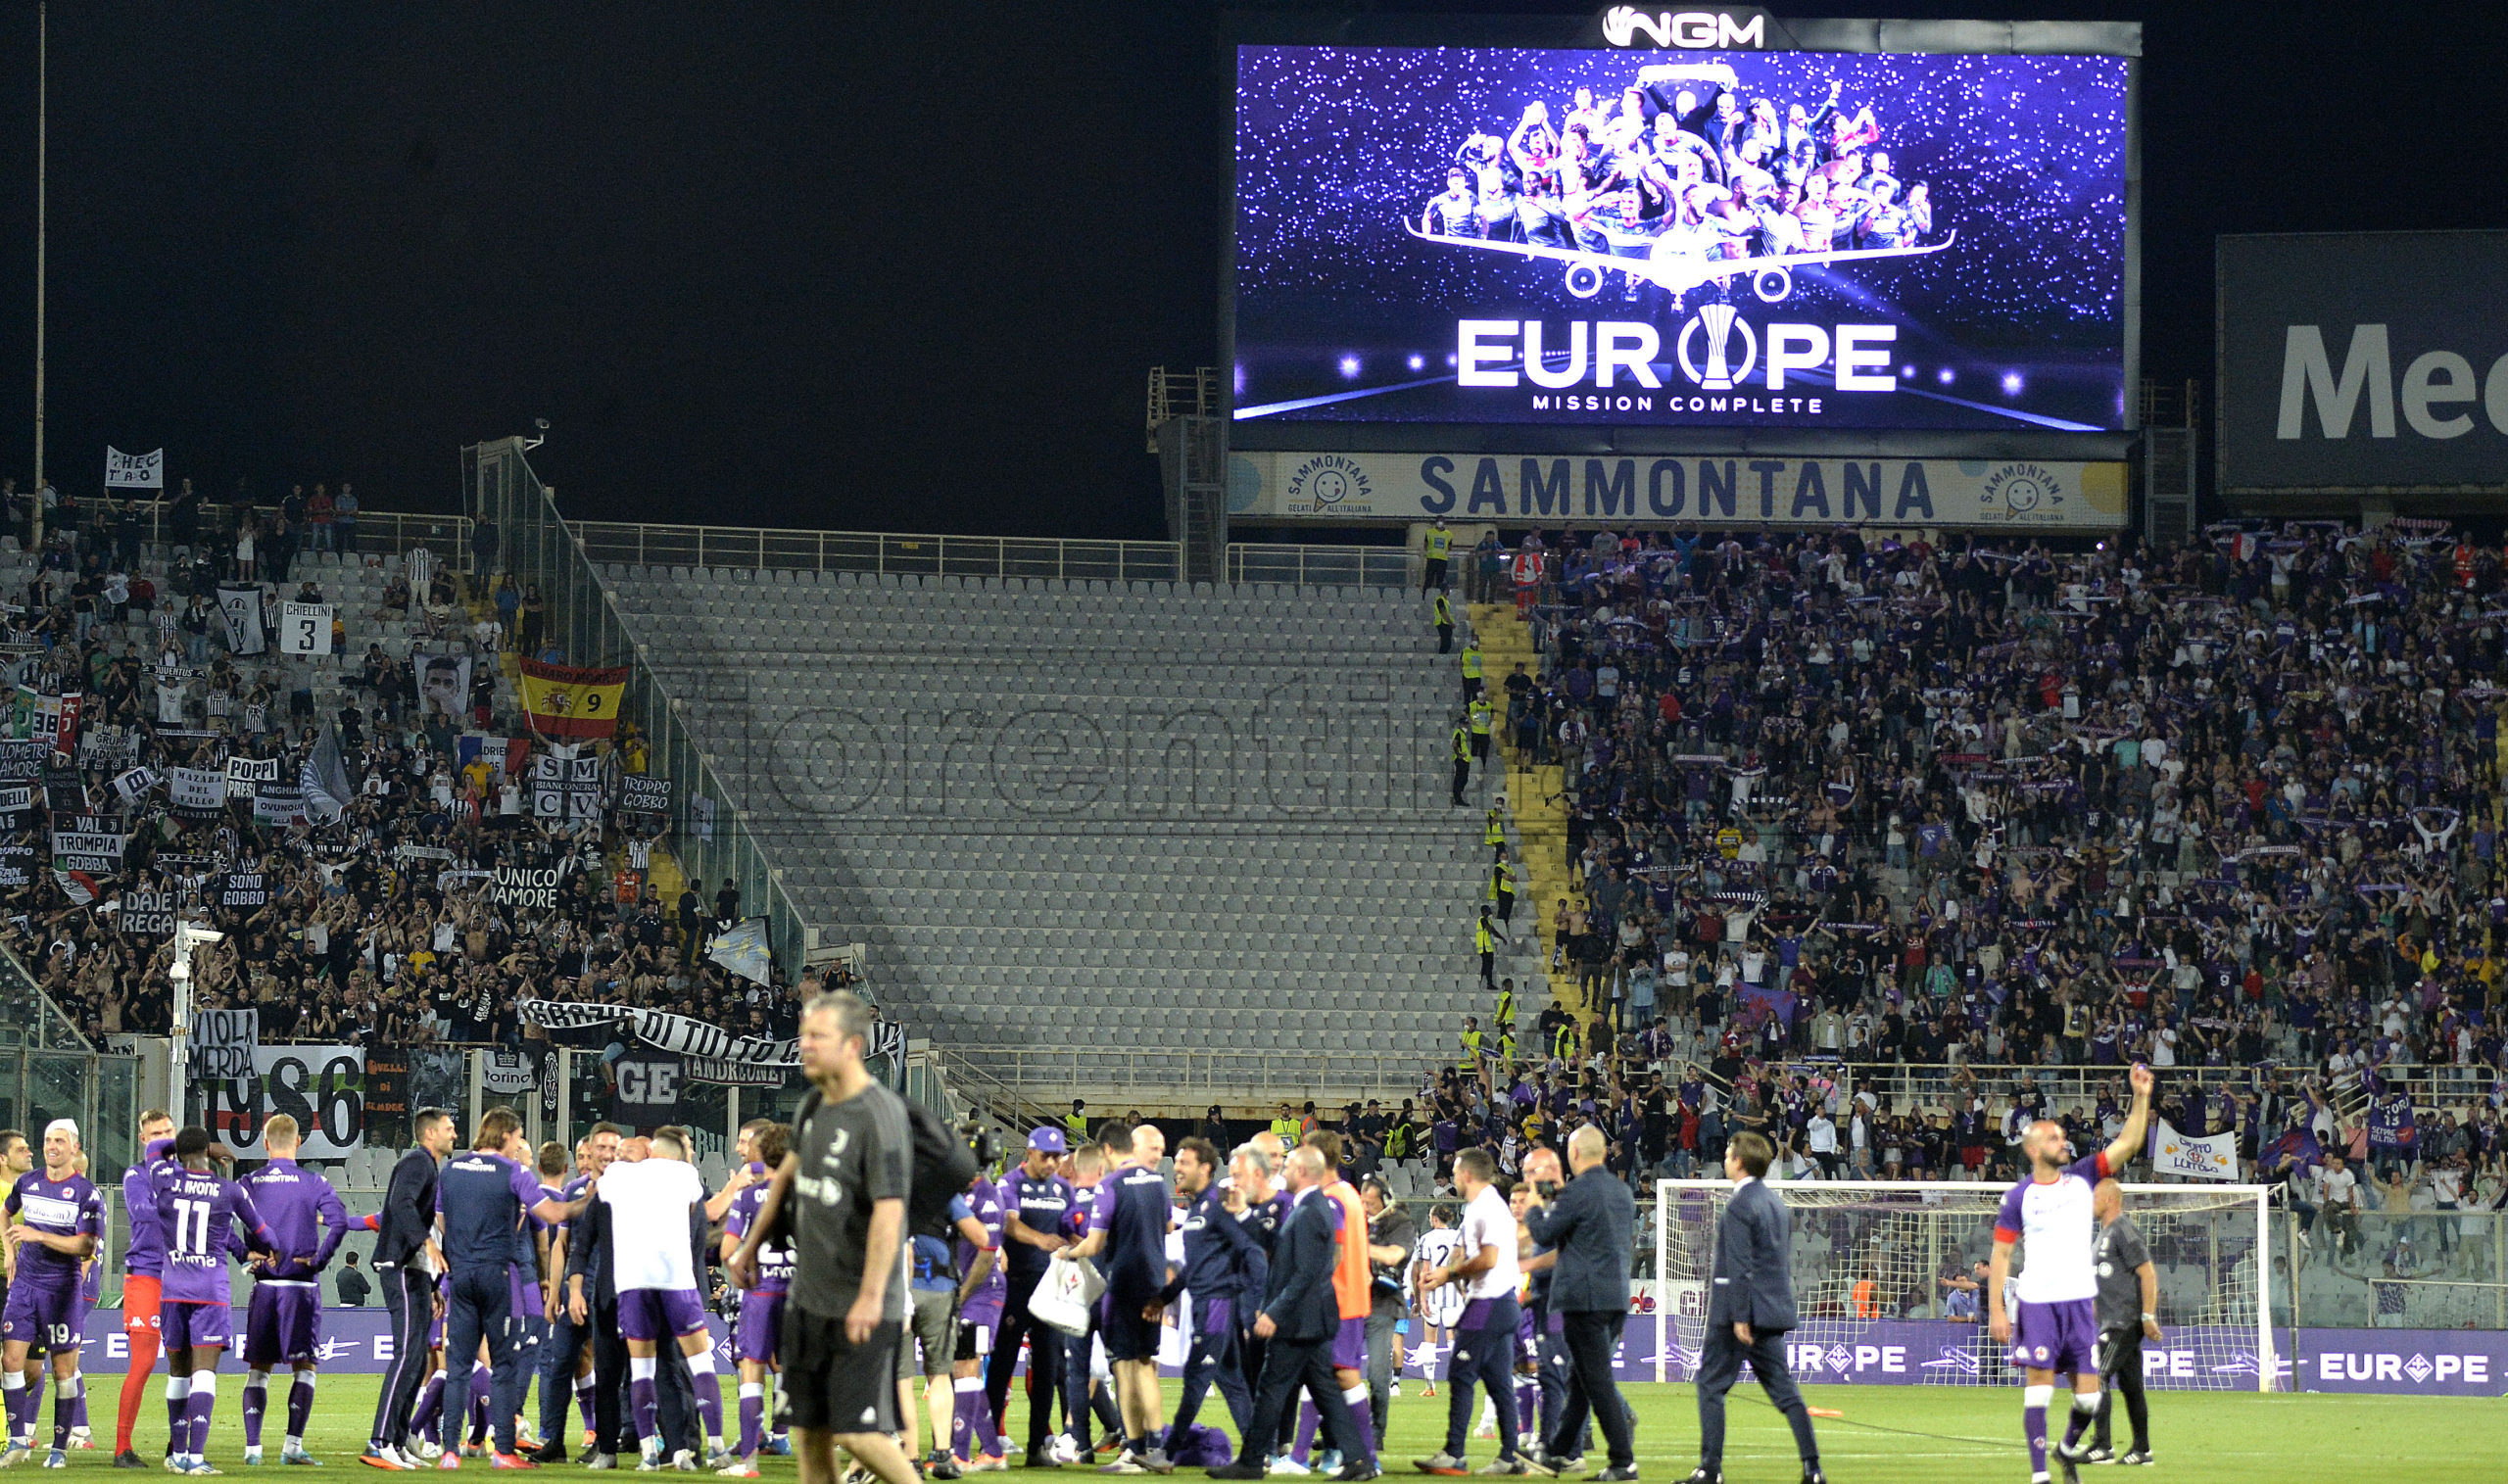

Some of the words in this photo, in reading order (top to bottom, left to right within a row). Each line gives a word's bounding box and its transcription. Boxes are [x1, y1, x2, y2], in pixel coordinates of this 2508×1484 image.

[1616, 12, 1763, 49] NGM
[1532, 396, 1652, 412] MISSION
[1669, 397, 1823, 414] COMPLETE
[1288, 455, 1372, 496] SAMMONTANA
[1980, 463, 2063, 504] SAMMONTANA
[1420, 455, 1935, 523] SAMMONTANA
[1288, 503, 1312, 512] GELATI
[1326, 503, 1372, 513] ALL'ITALIANA
[1980, 512, 2003, 521] GELATI
[286, 604, 331, 618] CHIELLINI
[299, 620, 316, 651] 3
[155, 665, 193, 677] JUVENTUS
[588, 694, 602, 713] 9
[96, 735, 130, 746] GRUPPO
[0, 743, 48, 760] LOMETRI
[177, 771, 221, 783] MAZARA
[230, 759, 275, 780] POPPI
[188, 785, 210, 794] DEL
[261, 785, 302, 794] ANGHIA
[536, 783, 598, 793] BIANCONERA
[624, 777, 672, 795] TROPPO
[179, 794, 215, 805] VALLO
[624, 794, 668, 811] GOBBO
[75, 816, 103, 834] VAL
[58, 837, 118, 853] TROMPIA
[66, 856, 112, 873] GOBBA
[228, 874, 263, 889] SONO
[497, 866, 557, 889] UNICO
[125, 891, 172, 912] DAJE
[222, 890, 265, 906] GOBBO
[495, 888, 557, 910] AMORE
[121, 912, 177, 933] REGA'
[639, 1011, 676, 1049] DI
[682, 1021, 777, 1065] TUTTO
[484, 1070, 531, 1086] torino
[206, 1055, 362, 1148] 1986
[252, 1173, 300, 1184] FIORENTINA
[172, 1197, 212, 1255] 11
[47, 1322, 70, 1345] 19
